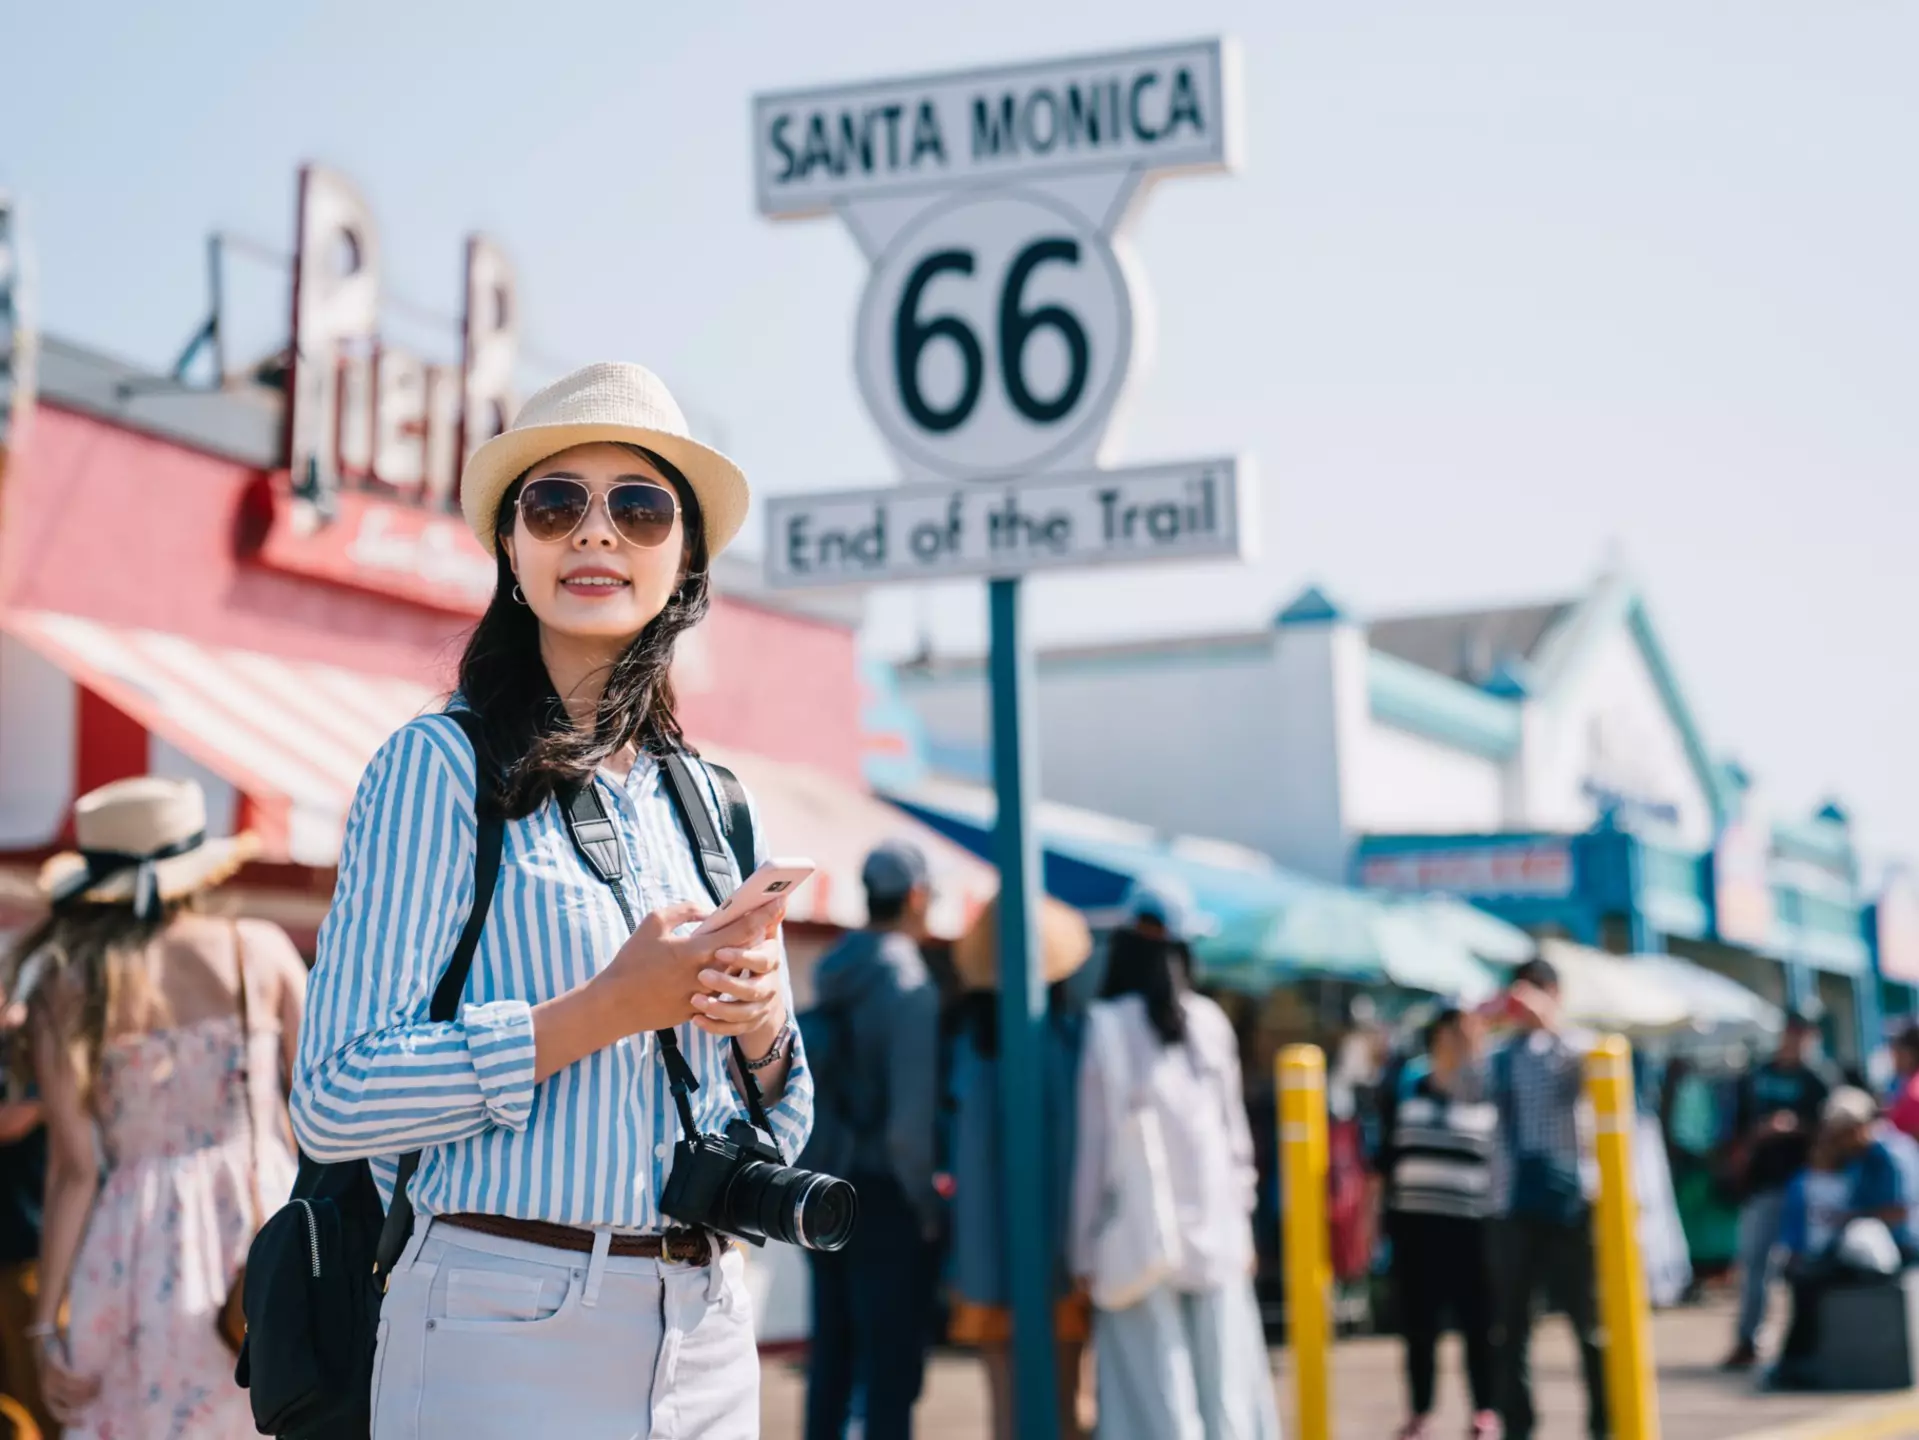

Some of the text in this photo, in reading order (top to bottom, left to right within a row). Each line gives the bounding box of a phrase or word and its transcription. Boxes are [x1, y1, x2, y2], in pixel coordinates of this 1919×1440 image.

[771, 66, 1207, 183] SANTA MONICA
[891, 235, 1091, 436] 66
[788, 470, 1218, 573] End of the Trail
